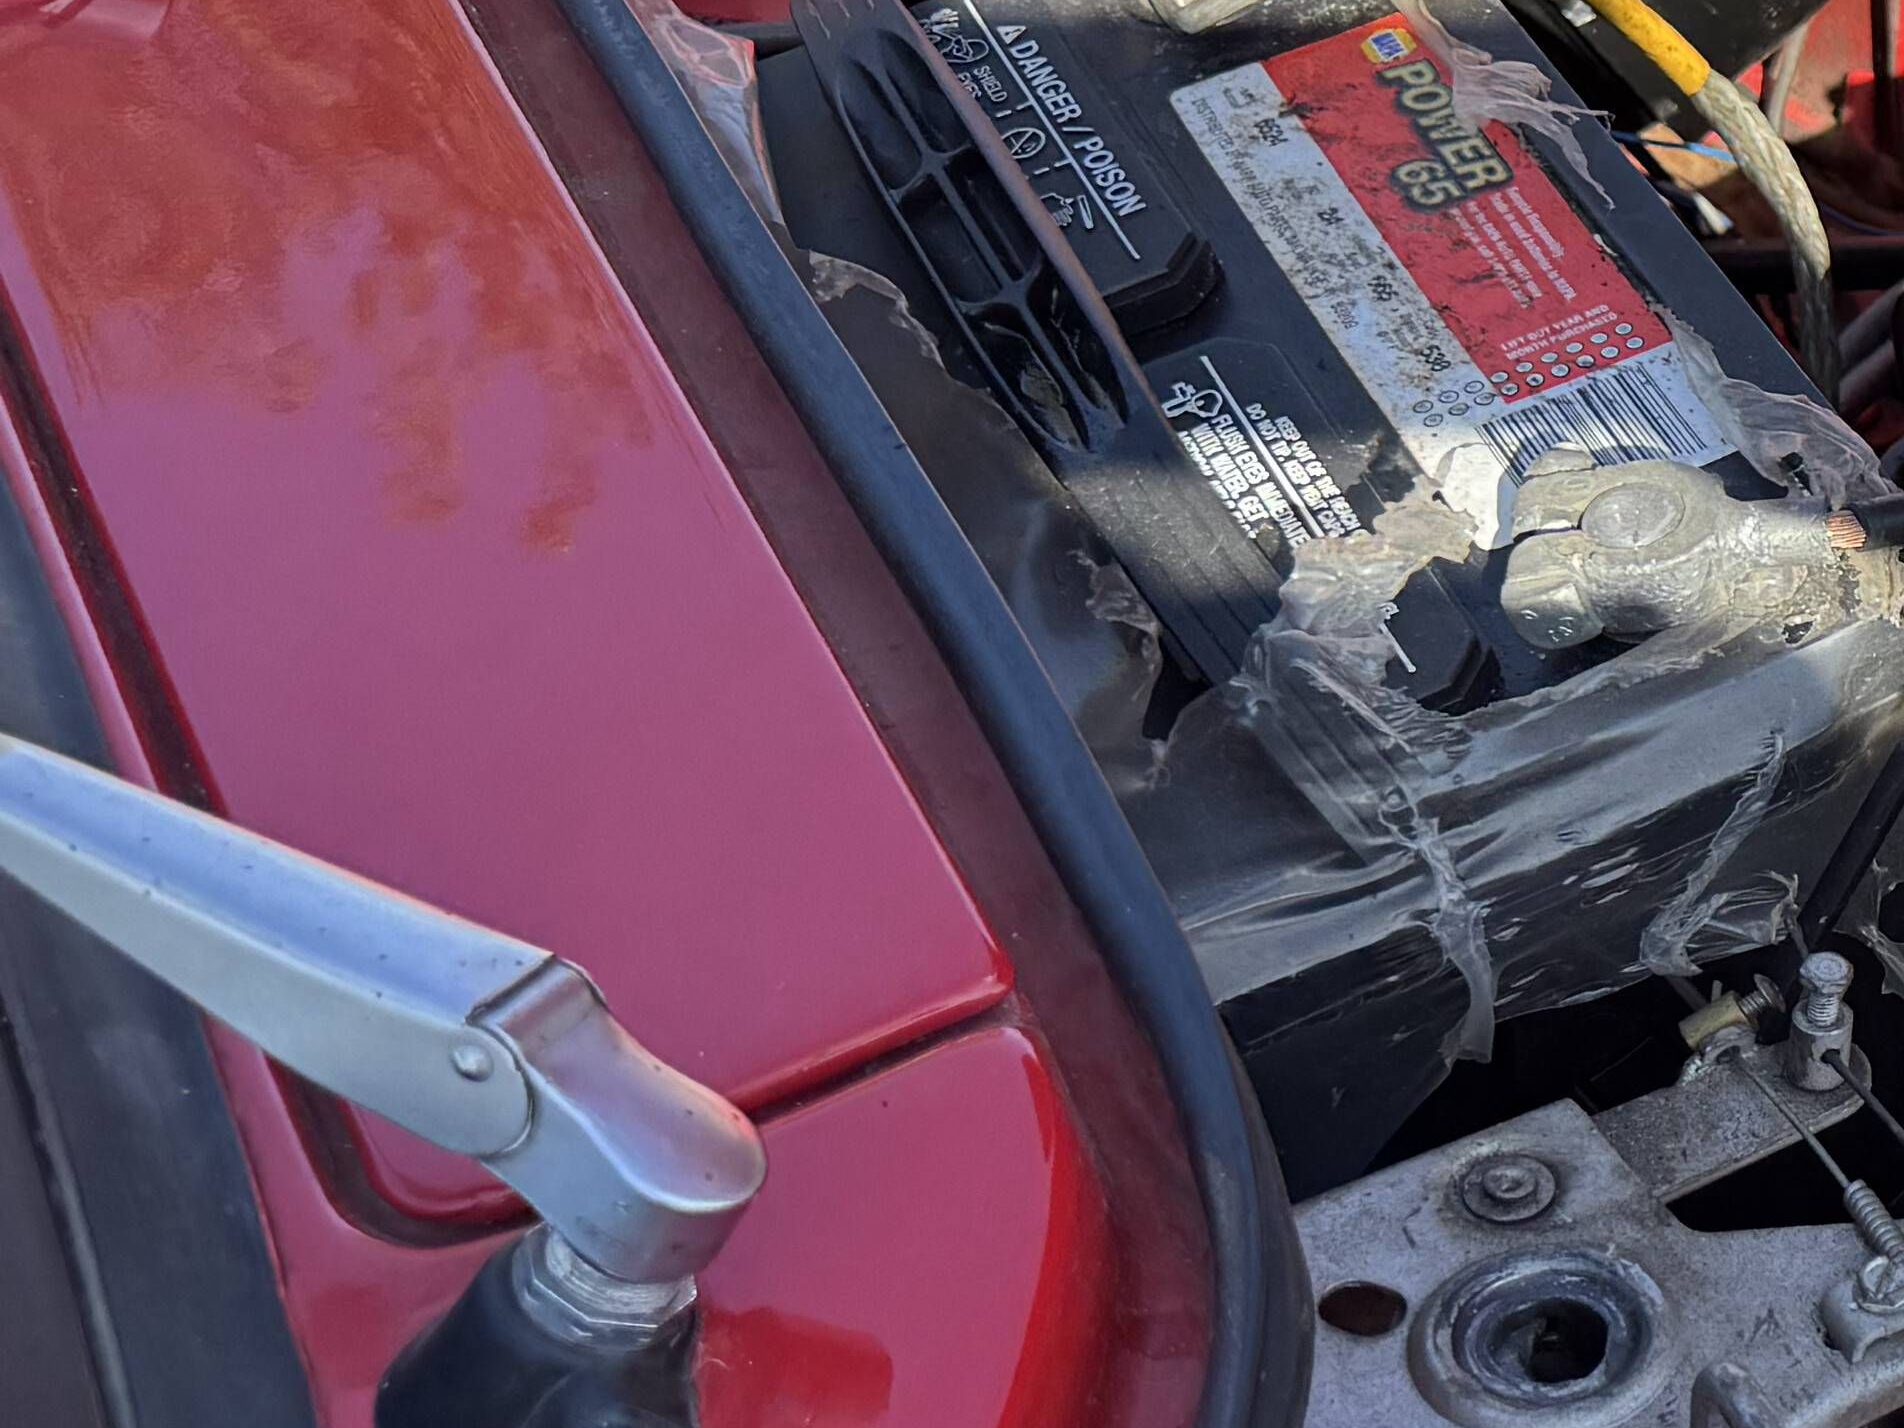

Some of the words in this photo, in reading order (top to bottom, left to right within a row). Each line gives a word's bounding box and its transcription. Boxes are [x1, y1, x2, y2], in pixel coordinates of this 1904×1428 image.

[1008, 35, 1083, 125] DANGER
[1071, 134, 1147, 219] POISON
[1380, 58, 1507, 192] POWER
[1397, 158, 1461, 209] 65
[1245, 402, 1267, 421] DO
[1255, 417, 1281, 442] NOT
[1210, 412, 1250, 455] FLUSH
[1233, 449, 1269, 485] EYES
[1254, 481, 1311, 549] IMMEDIATE
[1273, 415, 1301, 443] KEEP
[1291, 439, 1316, 463] OUT
[1315, 474, 1341, 499] THE
[1238, 495, 1269, 522] GET
